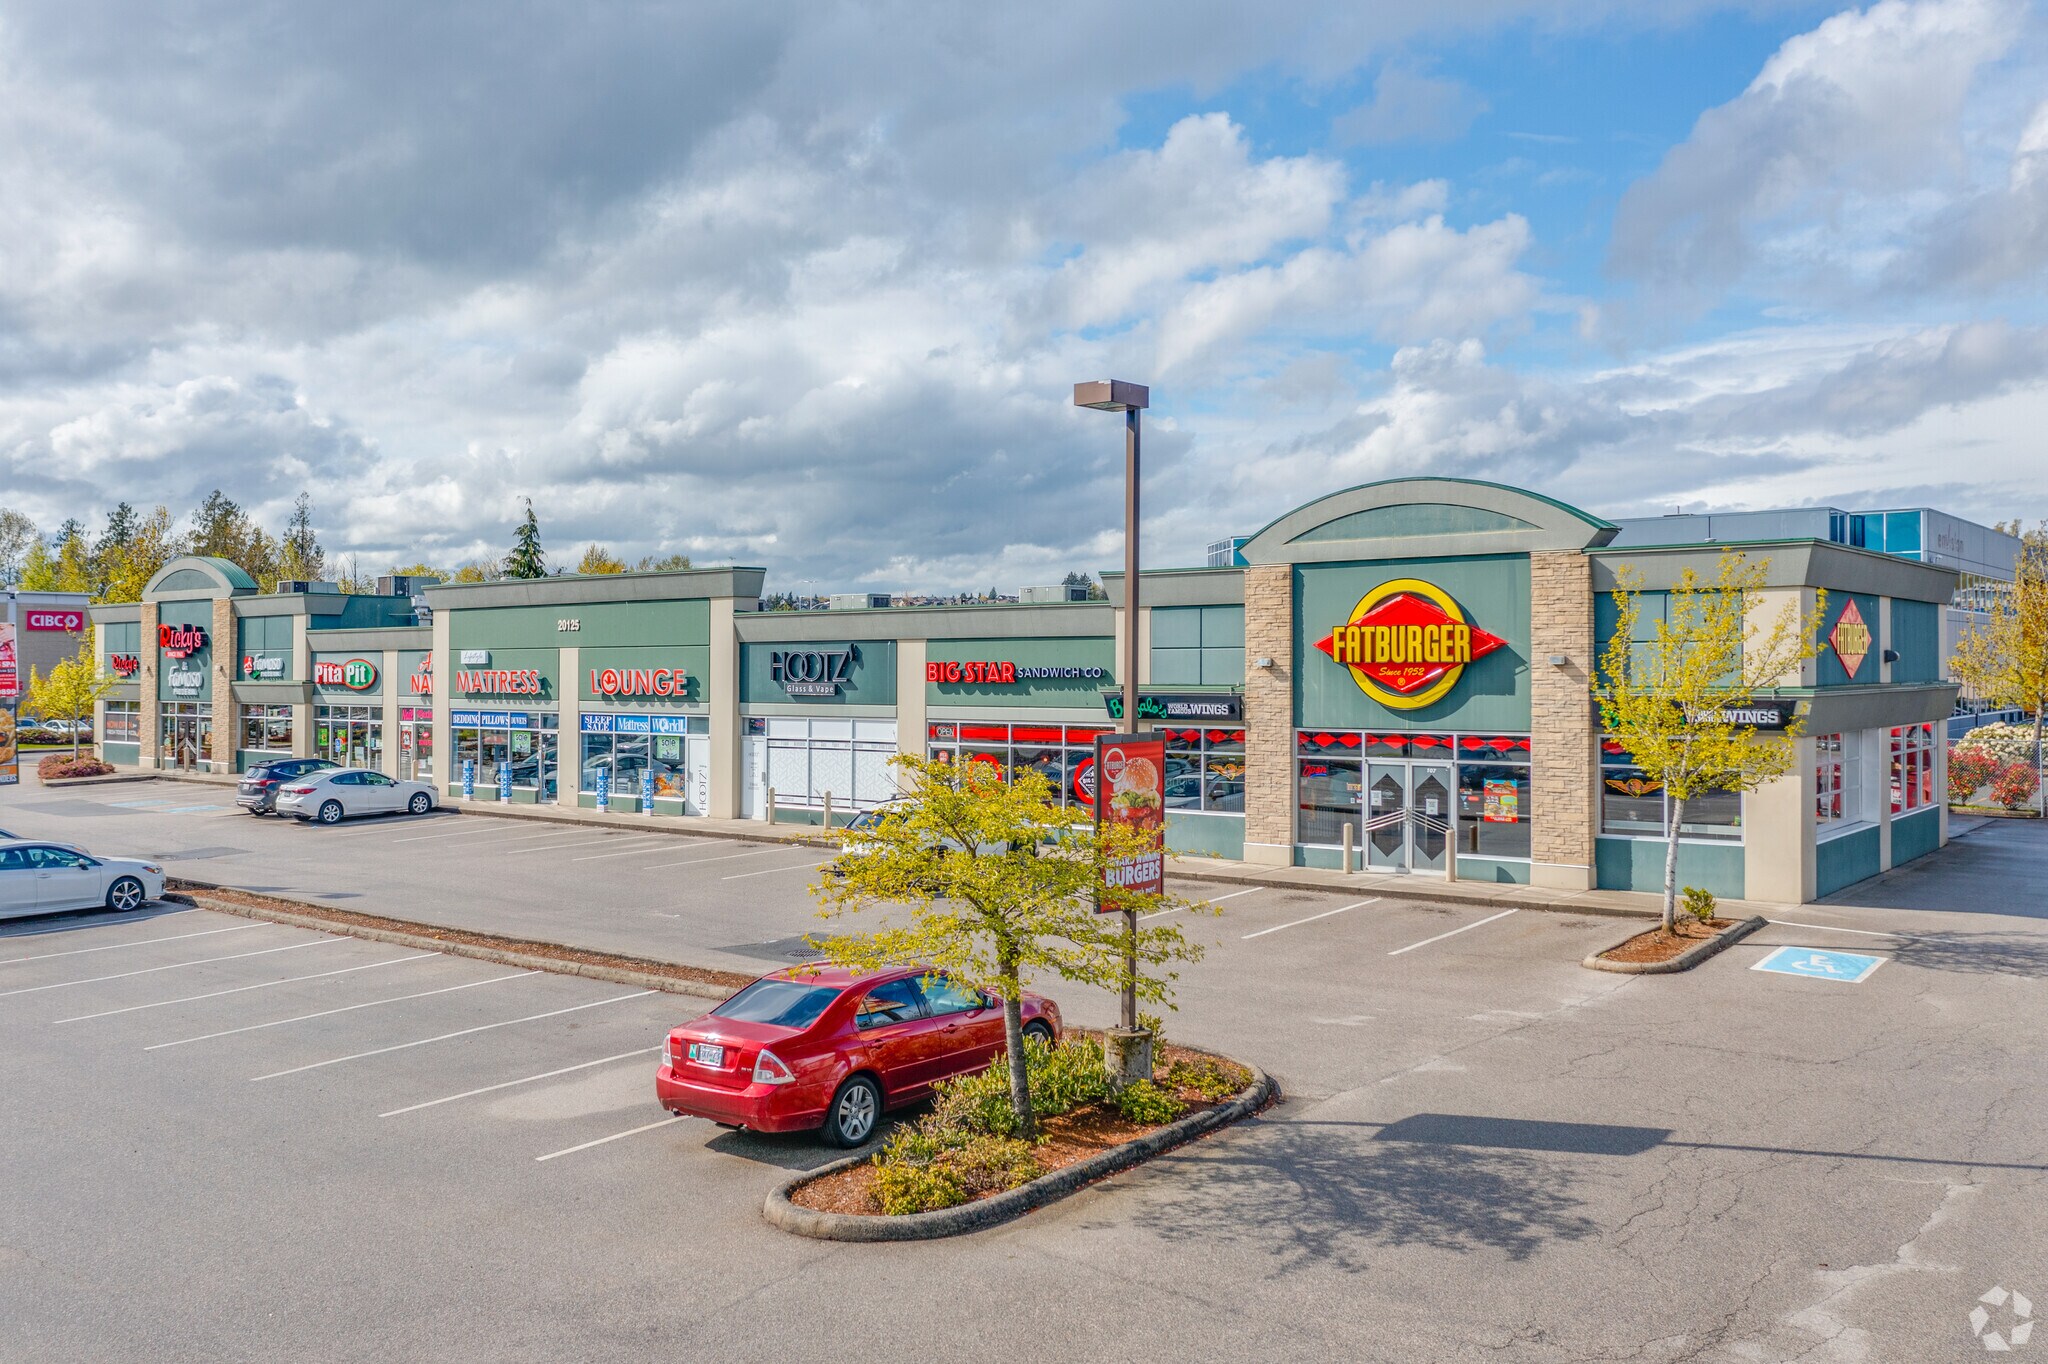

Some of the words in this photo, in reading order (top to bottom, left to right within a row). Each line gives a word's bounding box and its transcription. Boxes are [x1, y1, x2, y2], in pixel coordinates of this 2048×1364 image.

[31, 615, 64, 627] CIBC
[557, 619, 580, 631] 20125
[157, 623, 202, 653] Ricky's
[1332, 624, 1472, 663] FATBURGER
[111, 653, 139, 673] Ricky's
[315, 664, 343, 683] Pita
[346, 664, 367, 683] Pit
[927, 662, 961, 682] BIG
[964, 662, 1015, 682] STAR
[1018, 667, 1081, 678] SANDWICH
[1084, 667, 1103, 678] CO
[1379, 667, 1401, 676] Since
[1403, 667, 1425, 676] 1952
[456, 670, 541, 694] MATTRESS
[590, 668, 686, 696] LOUNGE
[815, 685, 834, 694] Vape
[1109, 697, 1168, 718] Balo's
[1190, 703, 1229, 715] WINGS
[453, 714, 479, 724] BEDDING
[482, 714, 509, 724] PILLOWS
[585, 715, 612, 724] SLEEP
[1721, 708, 1779, 724] WINGS
[587, 723, 610, 731] SALE
[618, 718, 648, 731] Mattress
[937, 727, 954, 736] OPEN
[1302, 765, 1327, 777] Open
[1105, 860, 1160, 888] BURGERS
